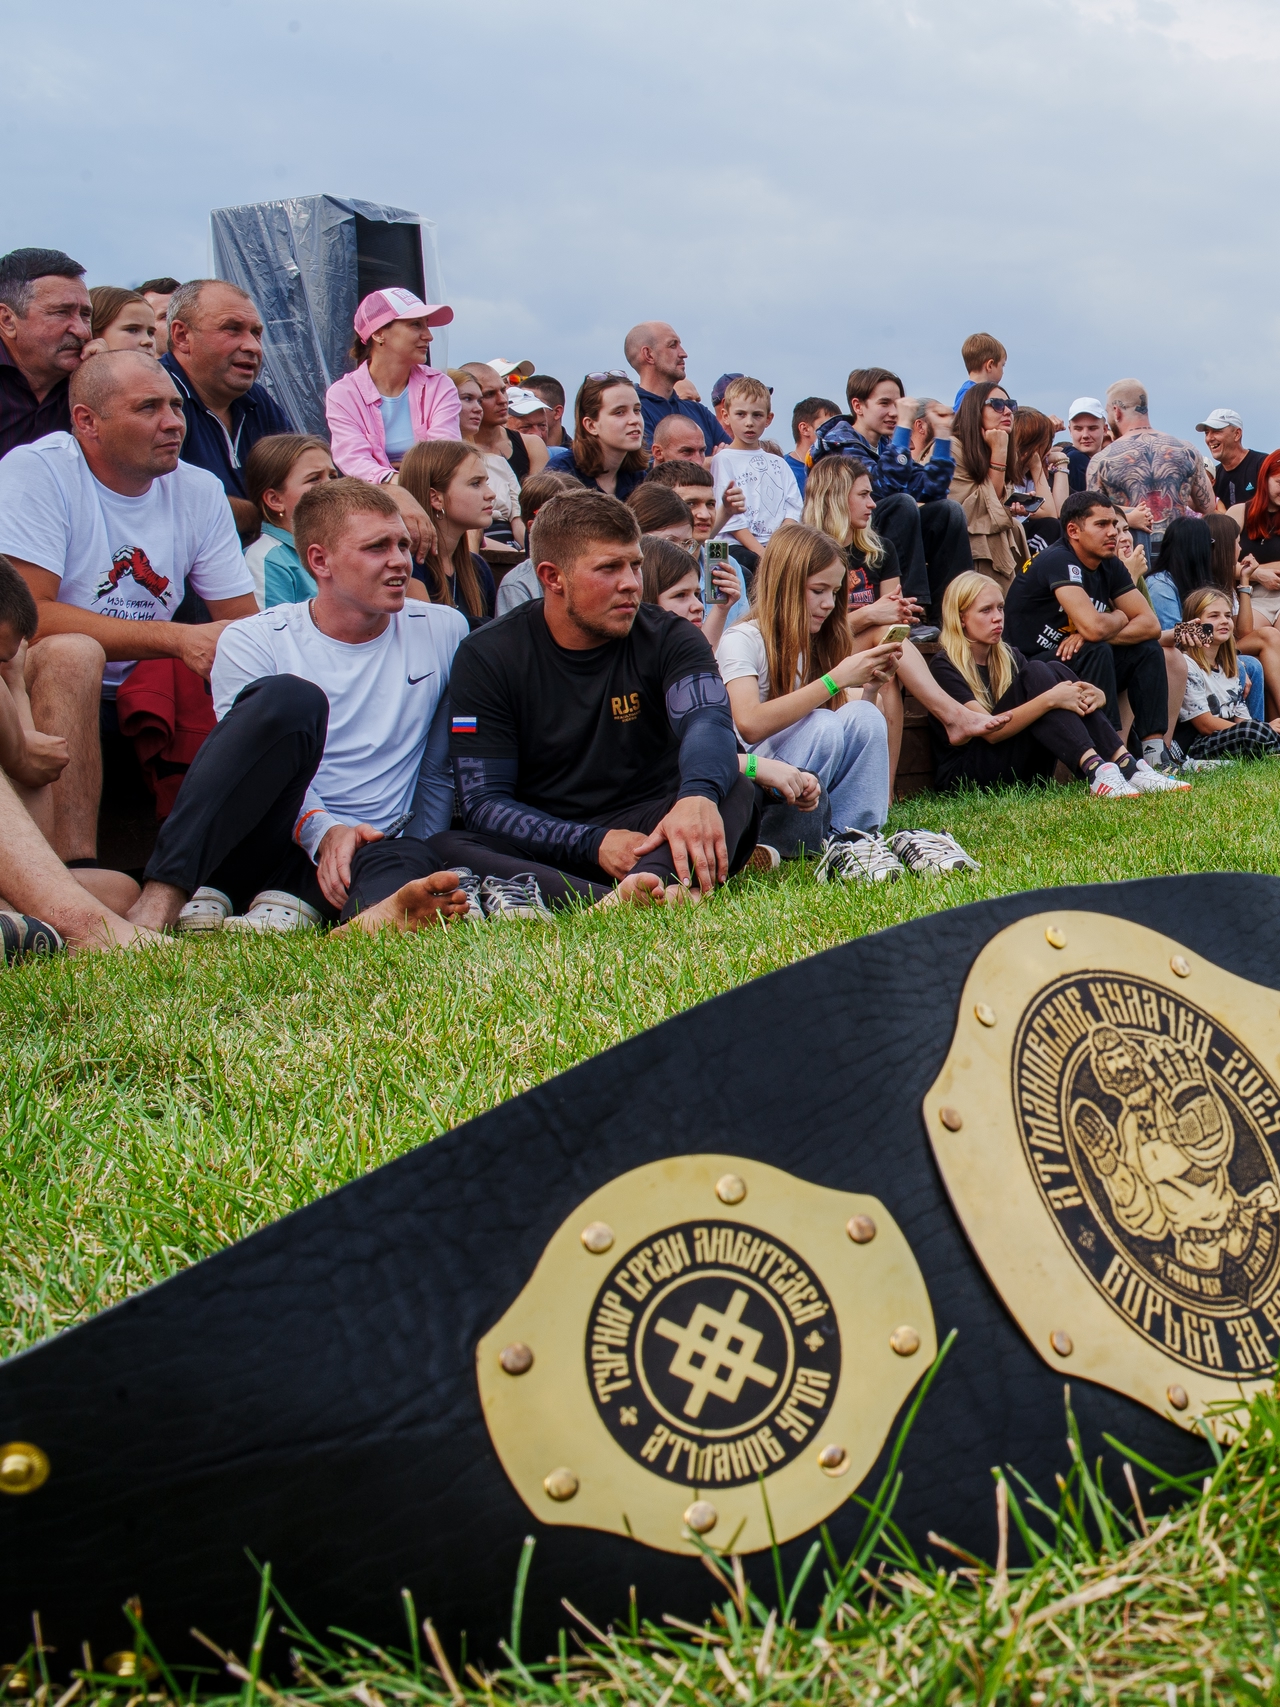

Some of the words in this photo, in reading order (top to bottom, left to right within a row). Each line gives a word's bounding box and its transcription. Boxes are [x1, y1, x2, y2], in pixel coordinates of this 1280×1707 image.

[1042, 624, 1063, 642] THE
[1022, 984, 1094, 1213] АТМАНОВСКИЕ
[591, 1290, 634, 1404] ТУРНИР
[614, 1231, 692, 1303] СРЕДИ
[693, 1225, 830, 1326] ЛЮБИТЕЛЕЙ
[1100, 1256, 1223, 1370] БОРЬБА
[640, 1422, 786, 1482] АТМАНОВ
[774, 1366, 832, 1443] УГОЛ
